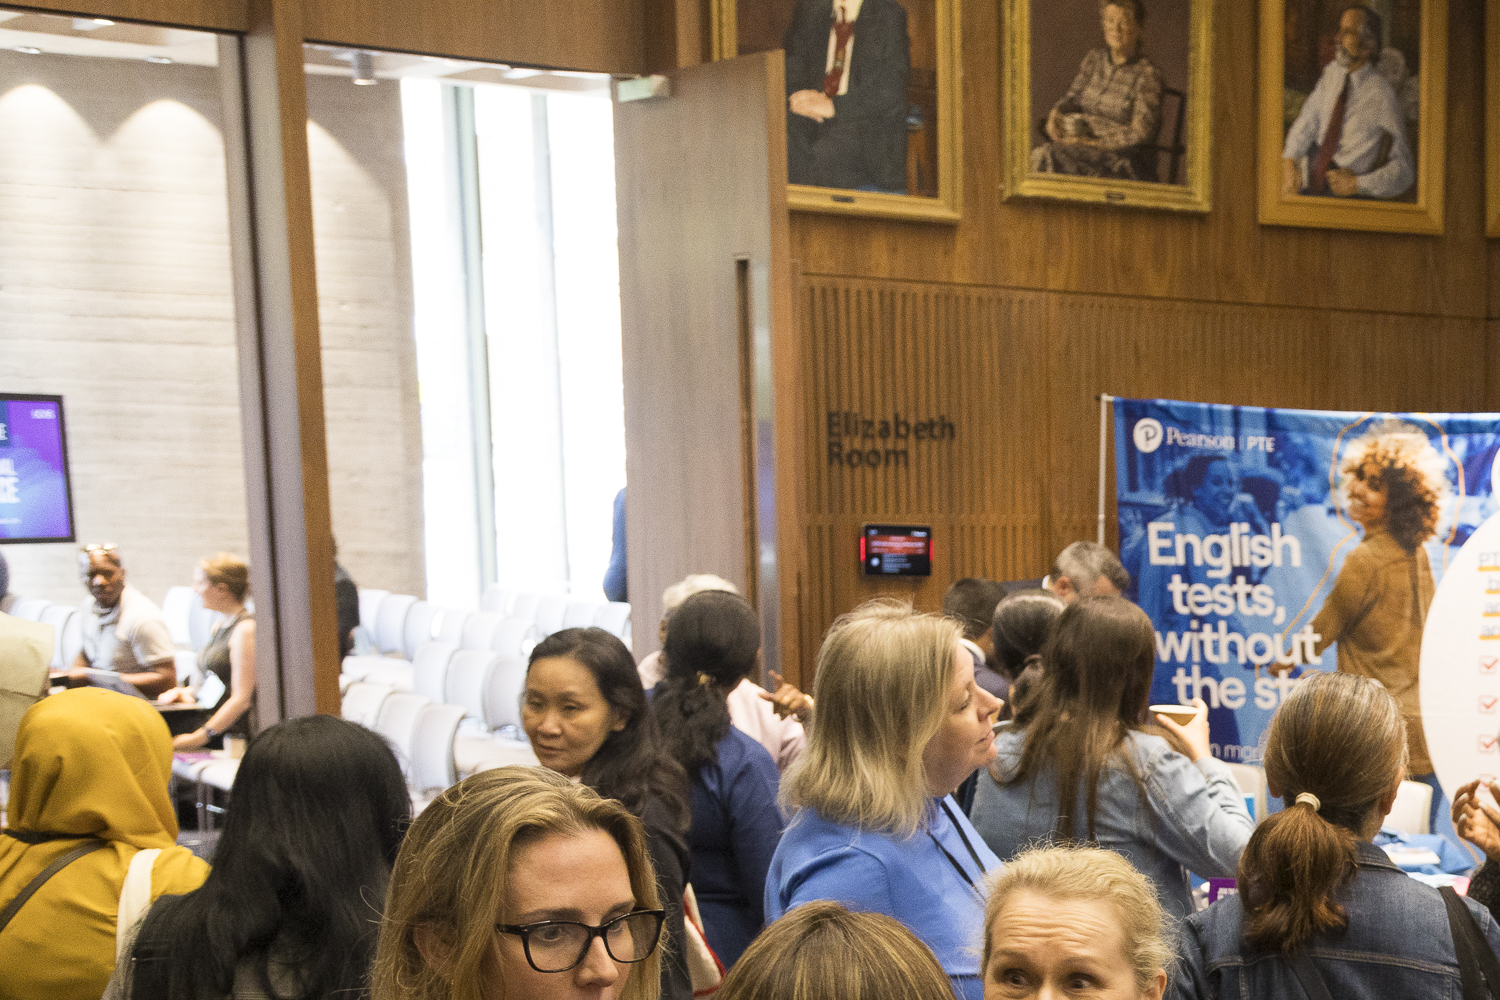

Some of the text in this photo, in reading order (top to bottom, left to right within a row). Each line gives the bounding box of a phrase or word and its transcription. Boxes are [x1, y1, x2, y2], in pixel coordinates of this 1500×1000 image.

[827, 411, 955, 440] Elizabeth
[1166, 426, 1275, 453] Pearson PTE
[827, 441, 909, 469] Room
[1147, 521, 1302, 579] English
[1167, 574, 1286, 626] tests,
[1155, 619, 1322, 666] without
[1171, 664, 1299, 710] the st
